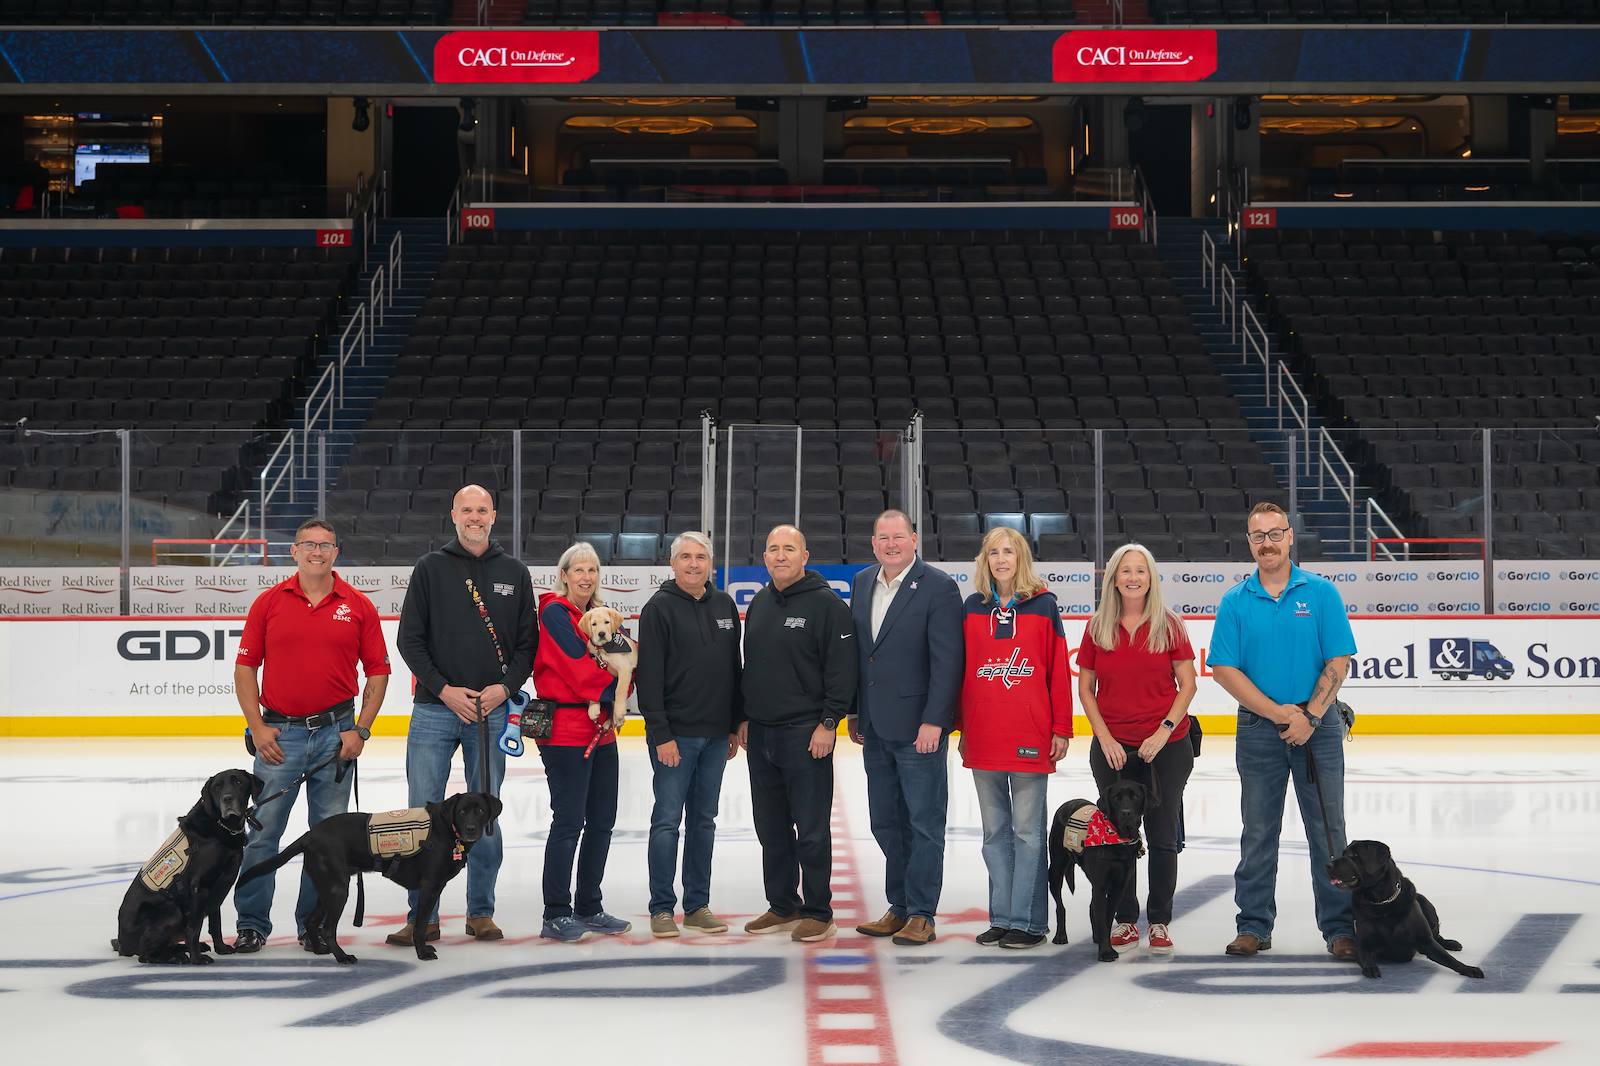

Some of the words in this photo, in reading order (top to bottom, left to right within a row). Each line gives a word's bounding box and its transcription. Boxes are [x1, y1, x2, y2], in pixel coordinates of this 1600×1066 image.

[458, 48, 507, 66] CACI
[511, 50, 525, 60] On
[527, 50, 564, 62] Defense
[1077, 47, 1125, 65] CACI
[1129, 49, 1144, 59] On
[1145, 49, 1182, 61] Defense
[466, 215, 490, 227] 100
[1115, 213, 1139, 225] 100
[1249, 213, 1270, 225] 121
[323, 233, 345, 244] 101
[23, 576, 51, 587] River
[62, 575, 83, 587] Red
[87, 575, 114, 587] River
[133, 575, 154, 586] Red
[157, 575, 184, 586] River
[195, 575, 216, 586] Red
[219, 575, 247, 586] River
[353, 575, 381, 586] River
[533, 574, 546, 585] ed
[611, 574, 640, 586] River
[23, 603, 51, 614] River
[62, 603, 83, 614] Red
[87, 603, 114, 614] River
[133, 603, 154, 614] Red
[157, 603, 184, 614] River
[195, 602, 216, 614] Red
[219, 602, 247, 613] River
[611, 602, 640, 613] River
[1057, 604, 1091, 613] ovCIO
[1182, 604, 1219, 613] GovCI
[332, 614, 351, 622] USMC
[1350, 643, 1418, 679] ael
[1436, 639, 1465, 669] &
[976, 647, 1034, 690] capitals
[130, 682, 149, 695] Art
[154, 681, 168, 695] of
[173, 682, 194, 695] the
[199, 682, 234, 698] possi
